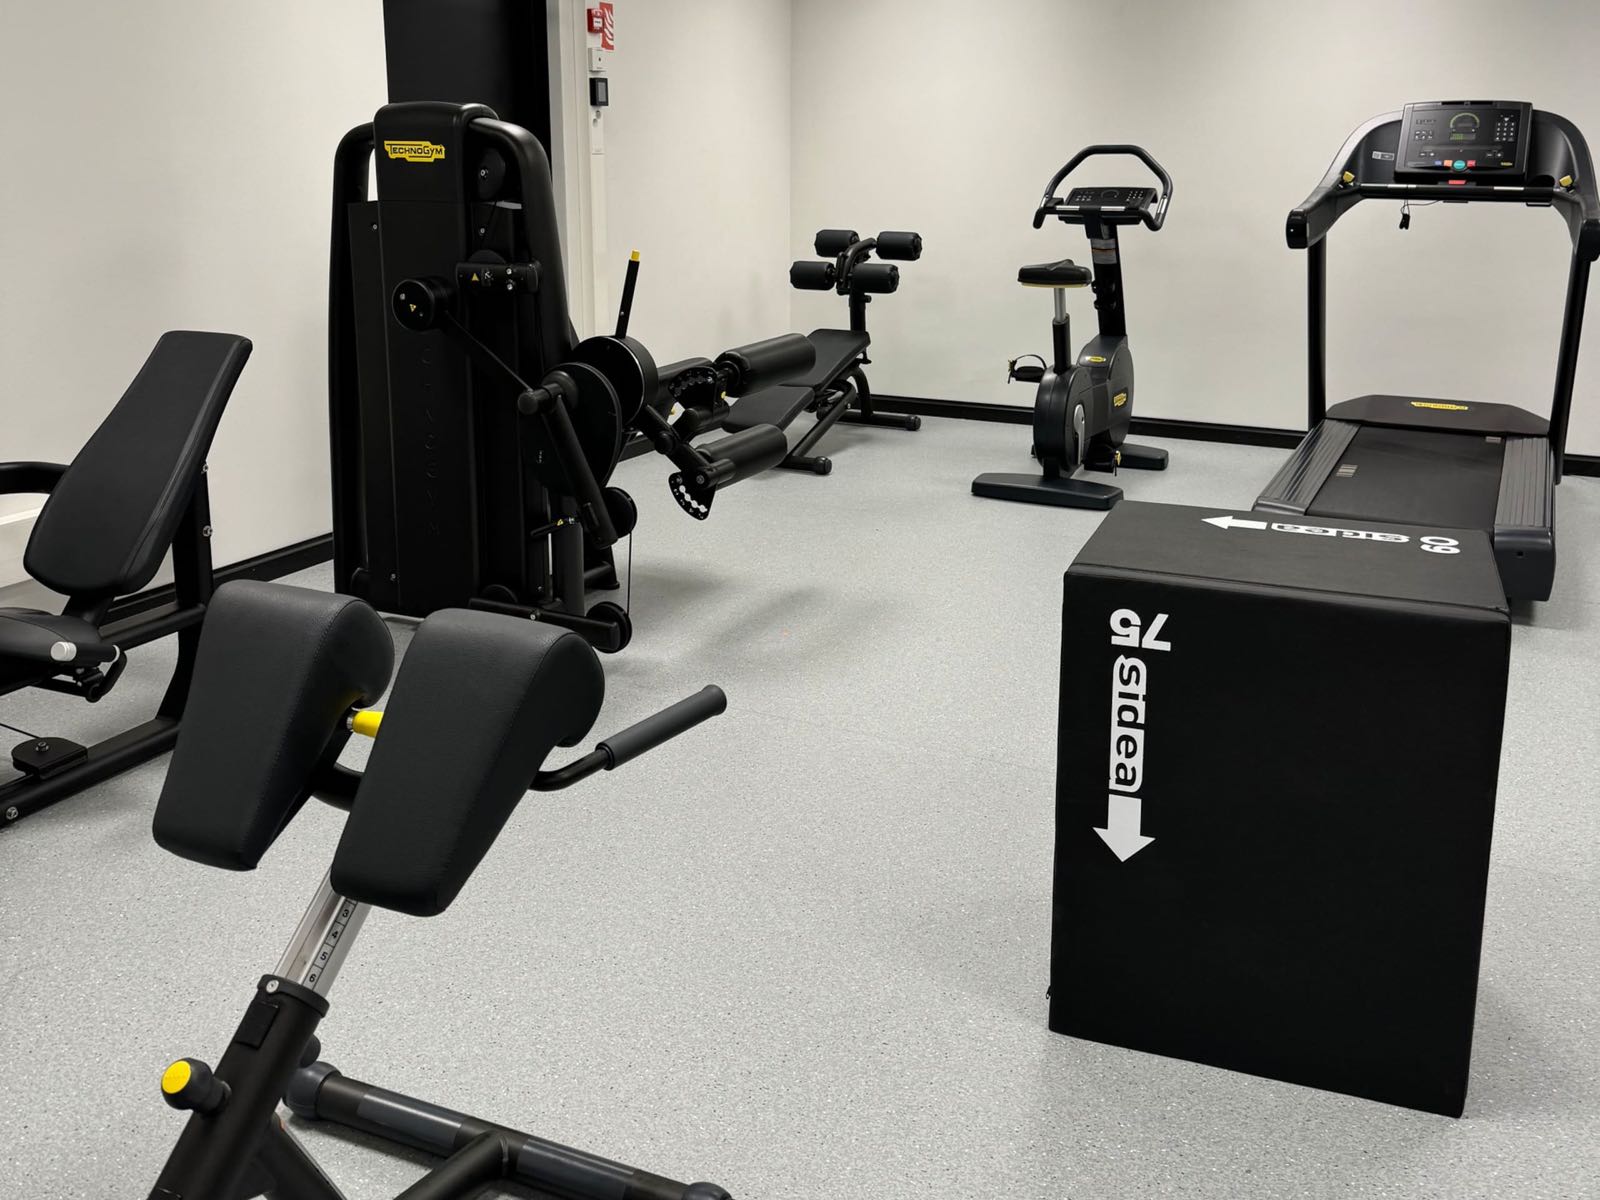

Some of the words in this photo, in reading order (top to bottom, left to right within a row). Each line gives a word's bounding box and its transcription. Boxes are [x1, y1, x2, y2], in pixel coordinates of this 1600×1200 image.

[1419, 535, 1461, 554] 60
[1109, 608, 1172, 652] 75
[1111, 657, 1147, 790] sidea
[342, 909, 349, 918] 3
[320, 952, 329, 961] 5
[309, 973, 317, 983] 6
